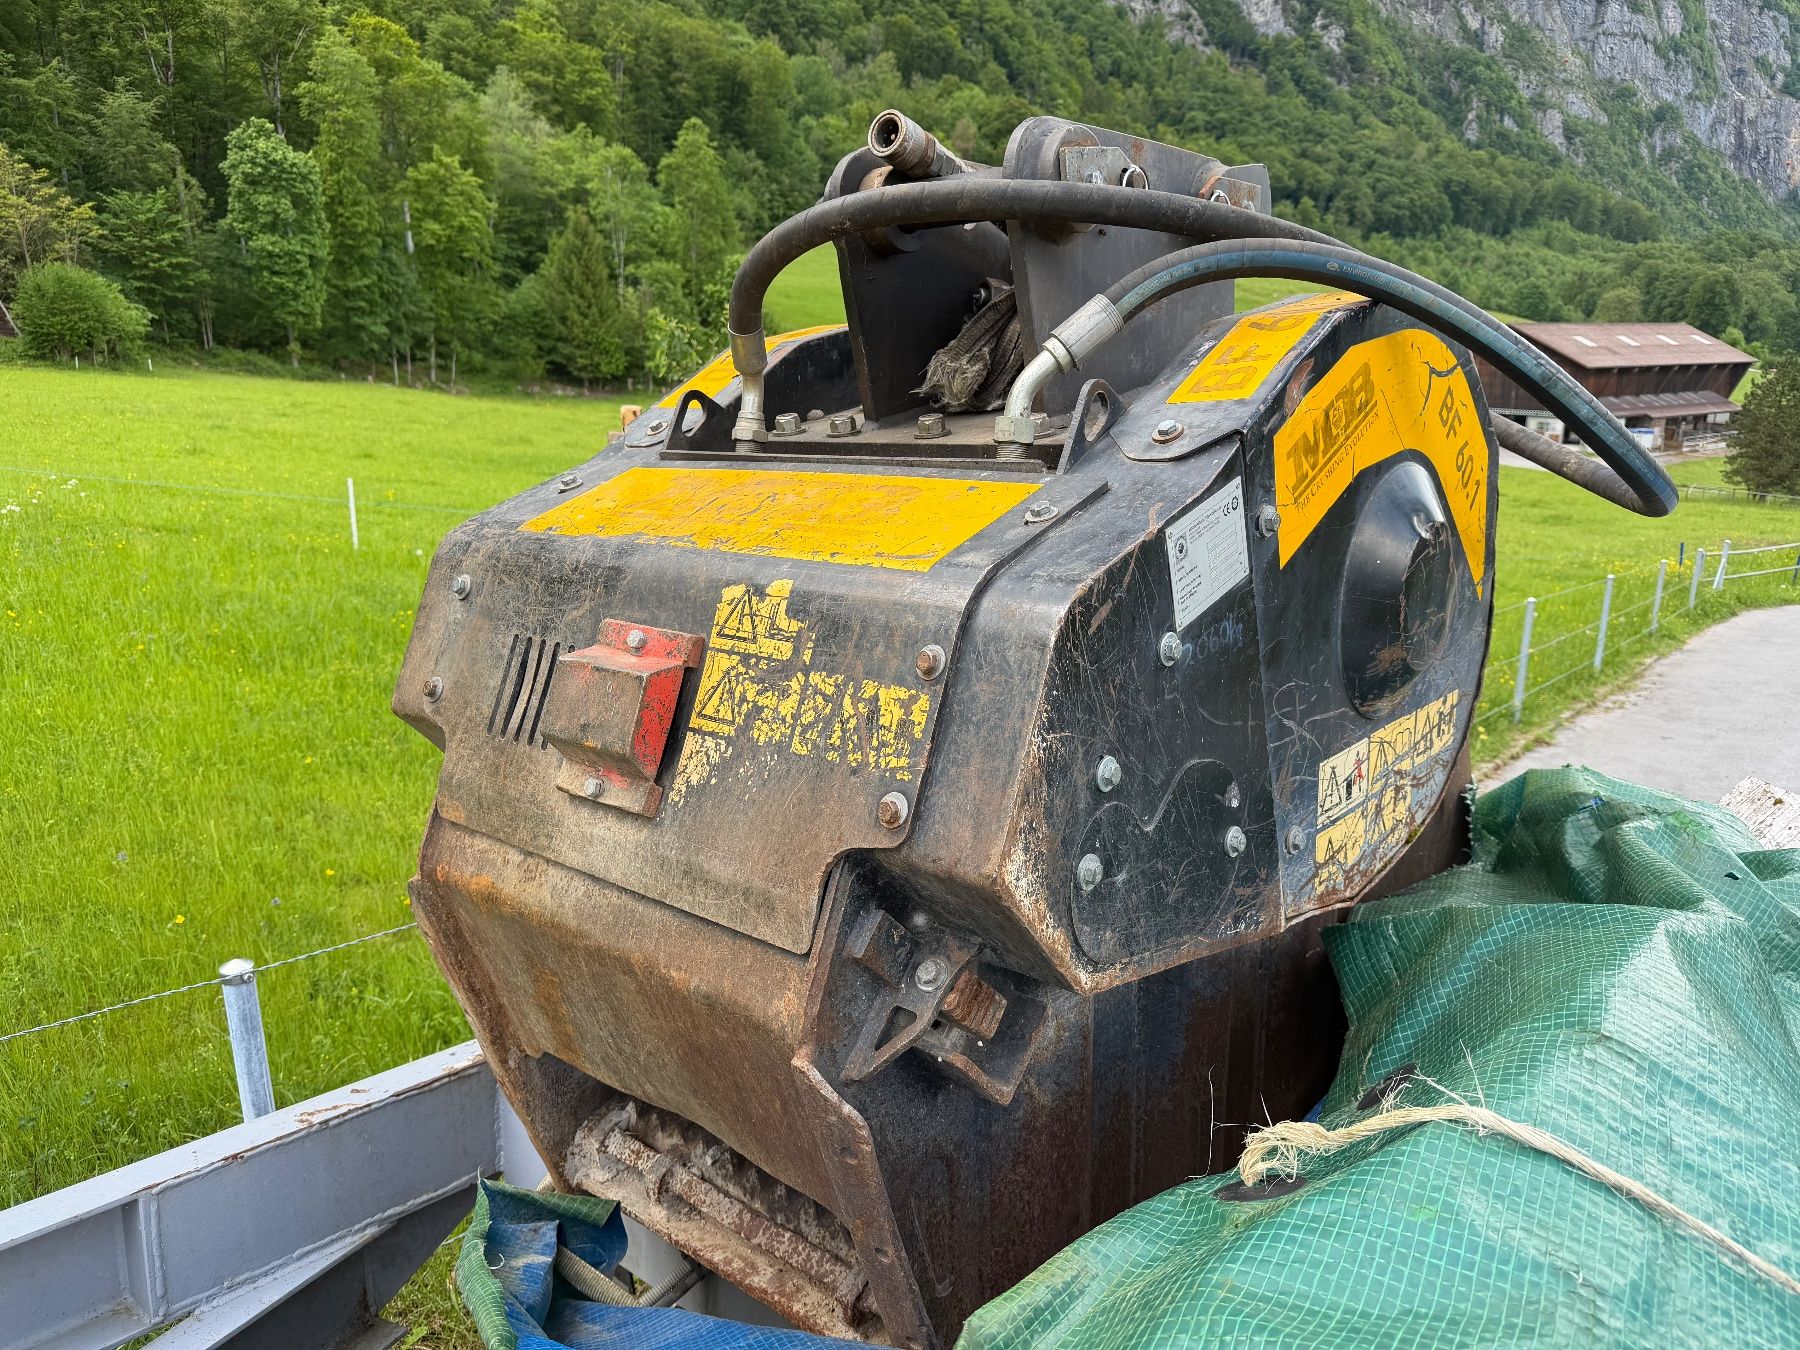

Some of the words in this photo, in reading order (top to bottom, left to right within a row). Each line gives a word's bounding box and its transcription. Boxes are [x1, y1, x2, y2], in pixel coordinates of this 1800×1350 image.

[1187, 345, 1272, 394] BF
[1286, 362, 1375, 495] MB
[1294, 493, 1311, 513] THE
[1310, 453, 1345, 498] CRUSHING
[1344, 409, 1380, 456] EVOLUTION
[1439, 384, 1462, 441] BF
[1456, 440, 1481, 511] 60.1
